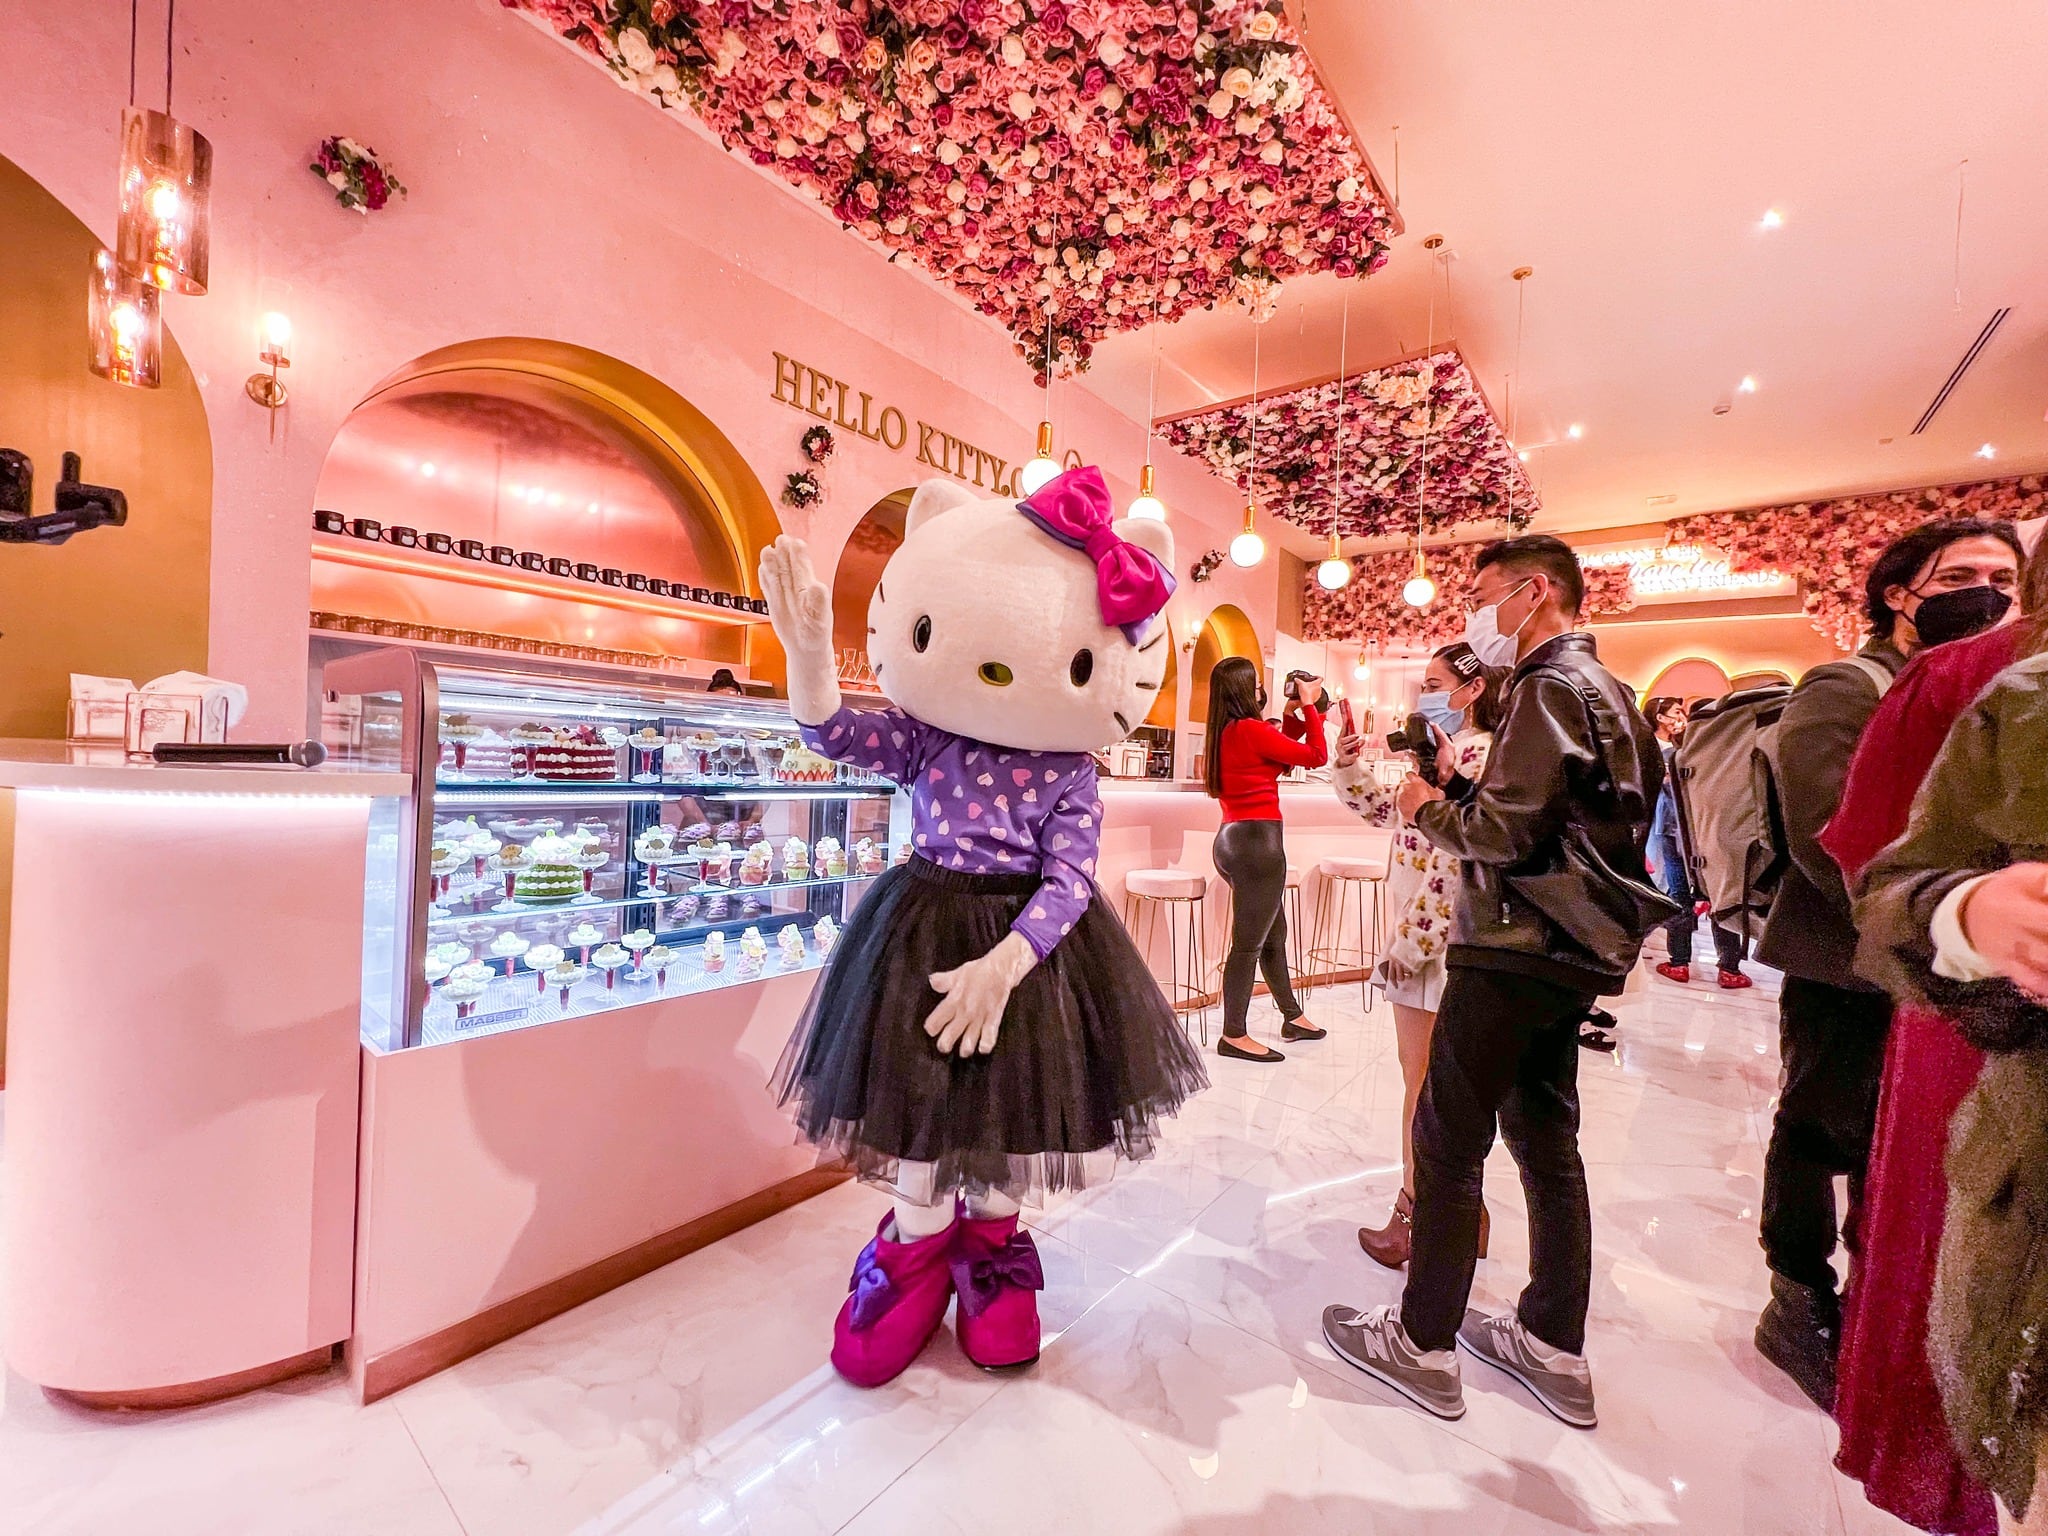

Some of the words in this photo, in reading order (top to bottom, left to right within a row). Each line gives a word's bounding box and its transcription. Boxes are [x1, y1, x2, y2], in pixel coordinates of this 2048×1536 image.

[771, 351, 907, 450] HELLO
[915, 420, 1008, 494] KITTY
[1697, 570, 1780, 588] FRIENDS
[1362, 1328, 1390, 1362] N
